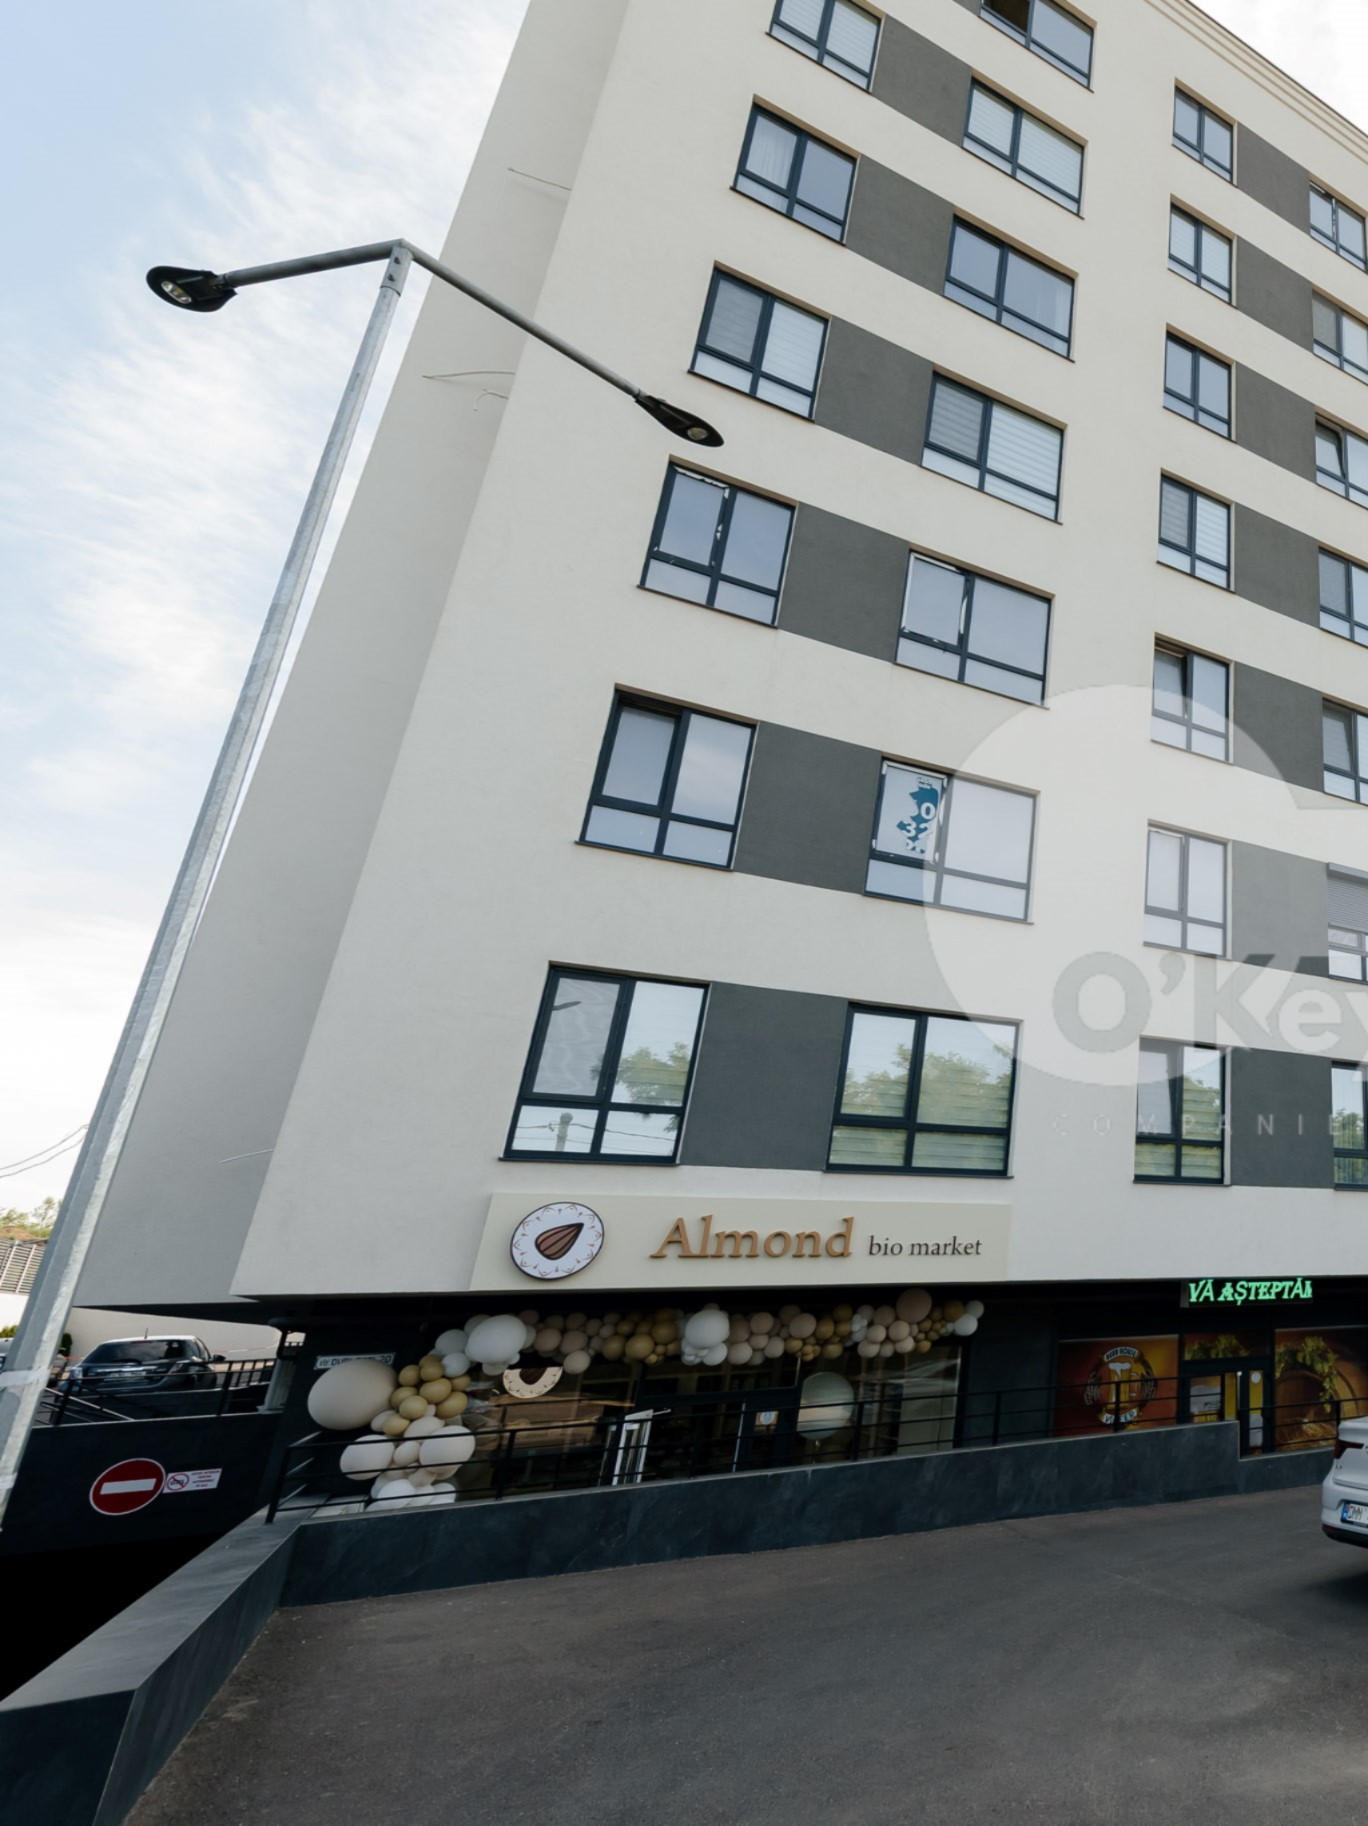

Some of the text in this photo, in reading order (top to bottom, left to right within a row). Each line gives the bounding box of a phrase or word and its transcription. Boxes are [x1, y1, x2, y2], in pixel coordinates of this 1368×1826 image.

[649, 1214, 983, 1259] Almond bio market
